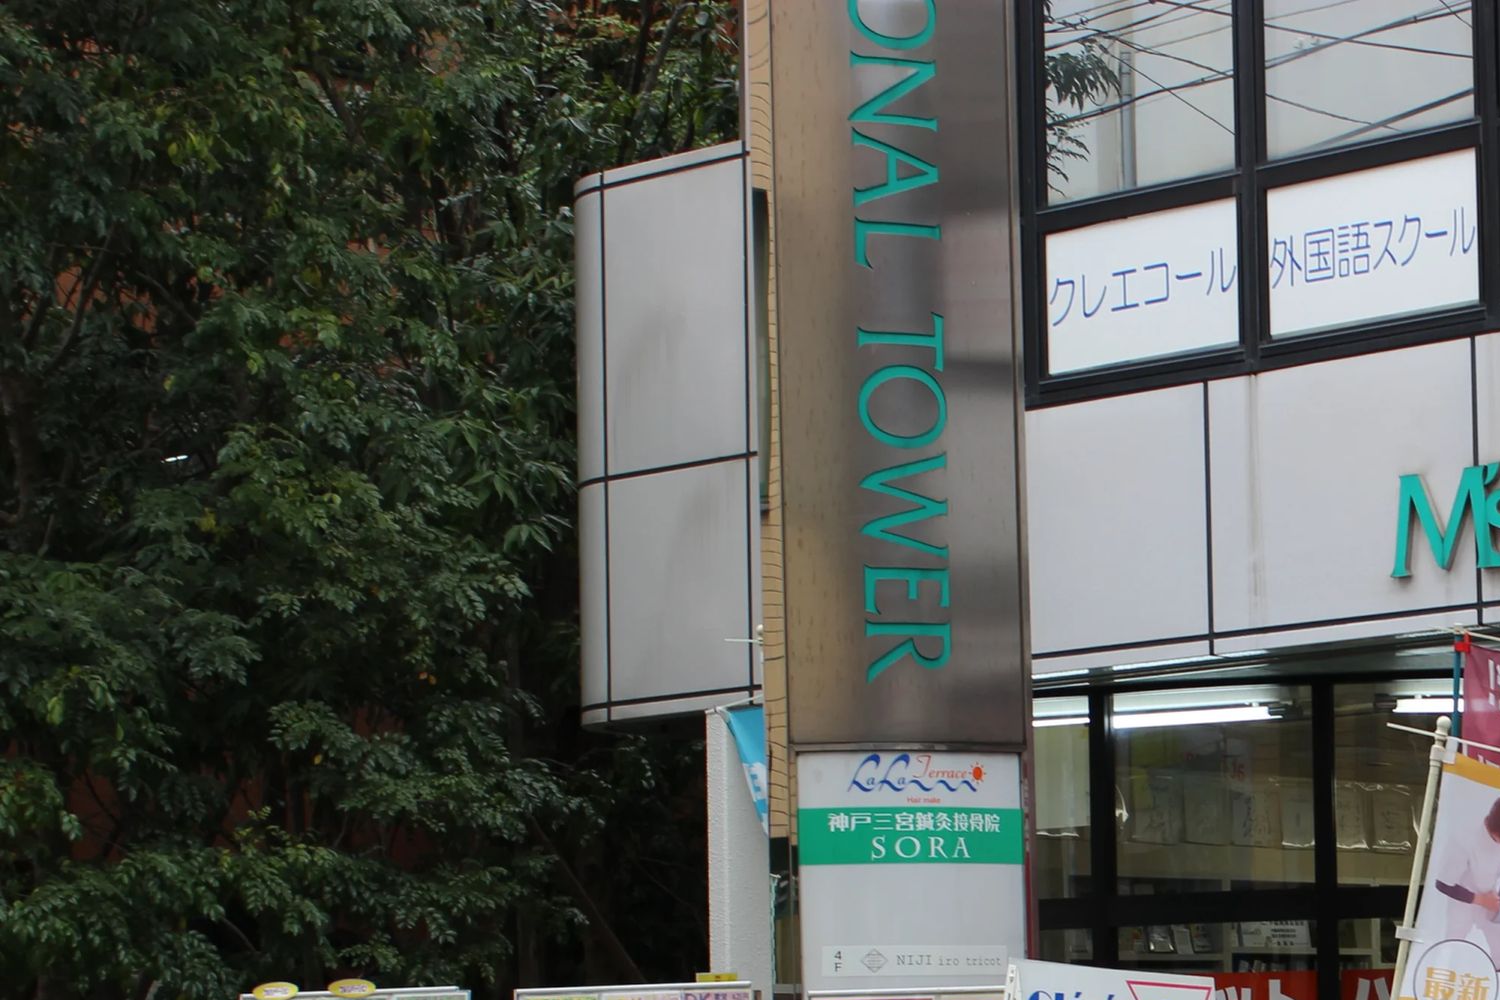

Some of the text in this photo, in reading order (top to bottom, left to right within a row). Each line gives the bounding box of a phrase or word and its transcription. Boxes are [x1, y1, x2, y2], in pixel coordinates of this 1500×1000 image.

[1268, 205, 1478, 292] 外国語スクール
[1048, 247, 1238, 328] クレエコール
[856, 312, 951, 684] TOWER
[913, 752, 968, 780] Terrace
[827, 811, 1001, 833] 神戸三宮鍼灸接骨院
[871, 835, 972, 861] SORA
[896, 954, 933, 967] NIJI
[965, 955, 1002, 967] tricot
